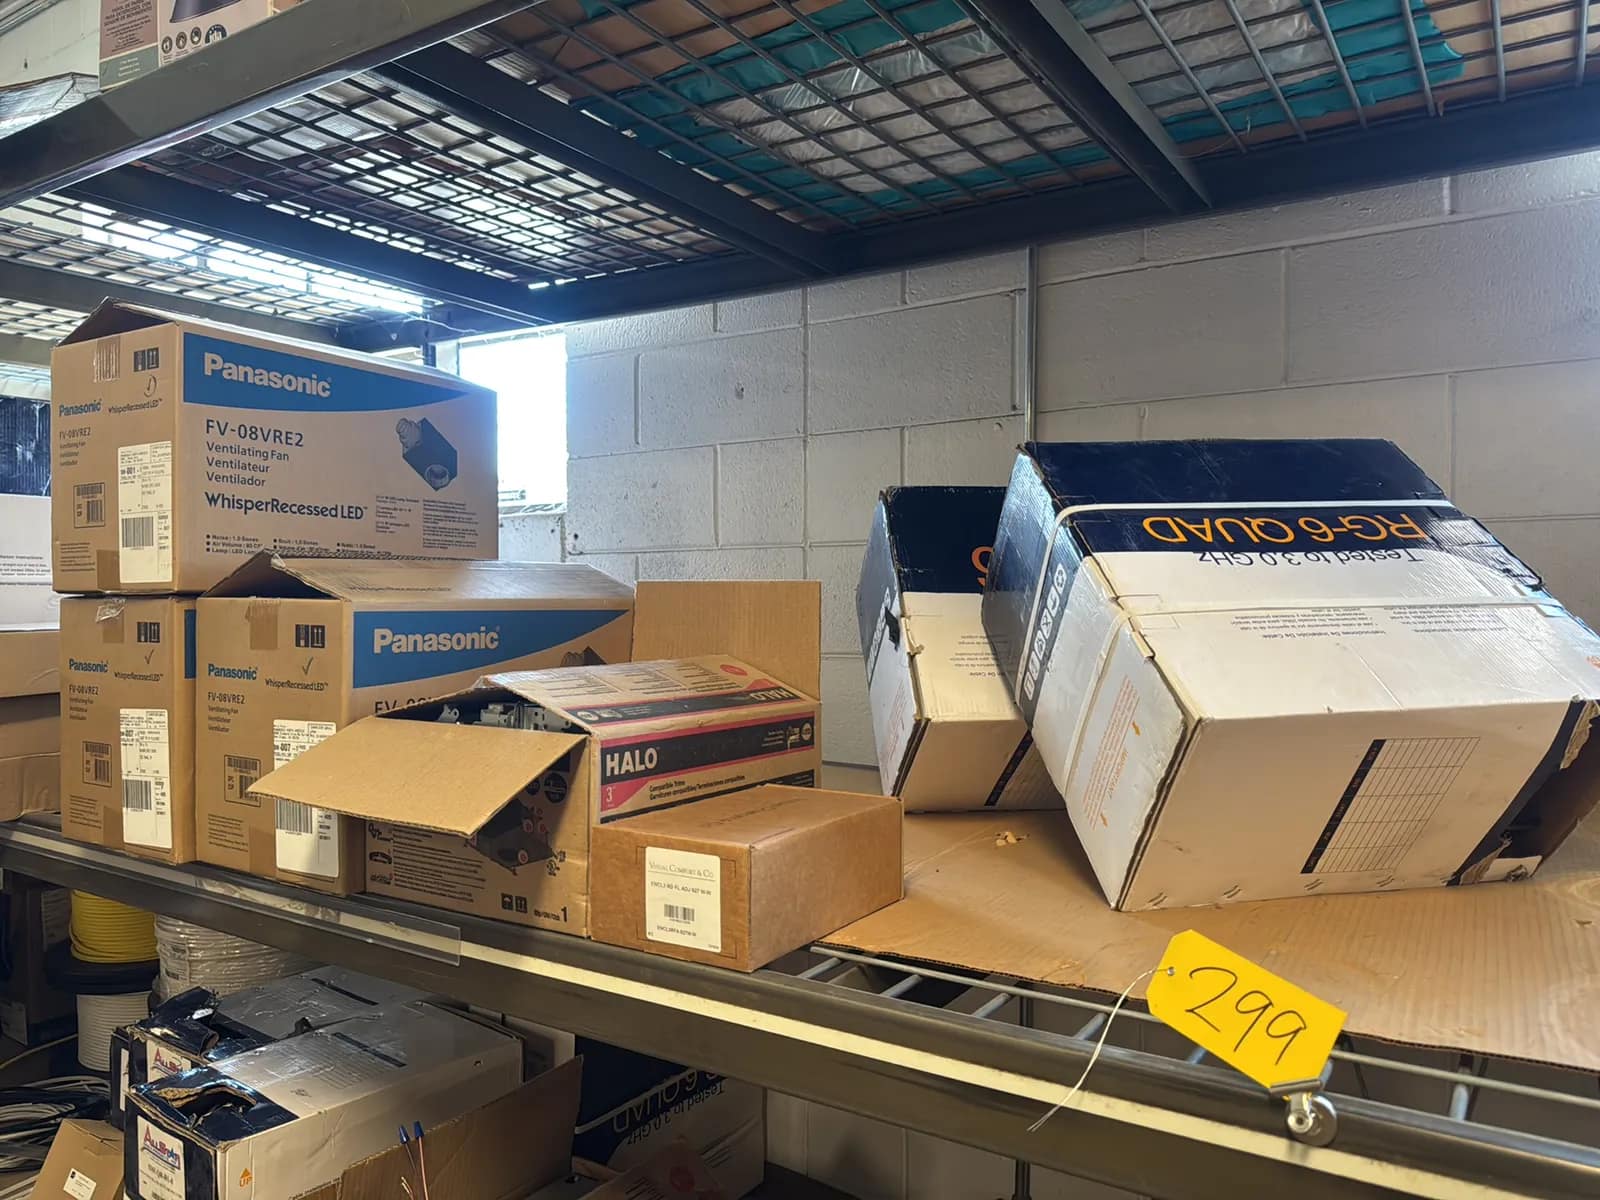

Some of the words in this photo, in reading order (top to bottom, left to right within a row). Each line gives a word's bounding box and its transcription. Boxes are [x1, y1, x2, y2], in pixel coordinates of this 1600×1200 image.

[204, 352, 331, 398] Panasonic
[59, 399, 102, 417] Panasonic
[206, 419, 304, 447] FV-08VRE2
[206, 441, 269, 461] Ventilating
[270, 449, 290, 462] Fan
[206, 456, 270, 473] Ventilateur
[206, 472, 266, 487] Ventilador
[1142, 516, 1295, 544] QUAD
[1298, 514, 1427, 542] RG-6
[1259, 551, 1302, 566] 3.0
[1304, 551, 1331, 563] to
[1337, 549, 1424, 565] Tested
[373, 626, 499, 654] Panasonic
[69, 658, 108, 673] Panasonic
[208, 663, 257, 680] Panasonic
[208, 692, 245, 705] FV-08VRE2
[606, 747, 658, 777] HALO
[1185, 966, 1307, 1066] 299
[240, 1176, 253, 1188] UP
